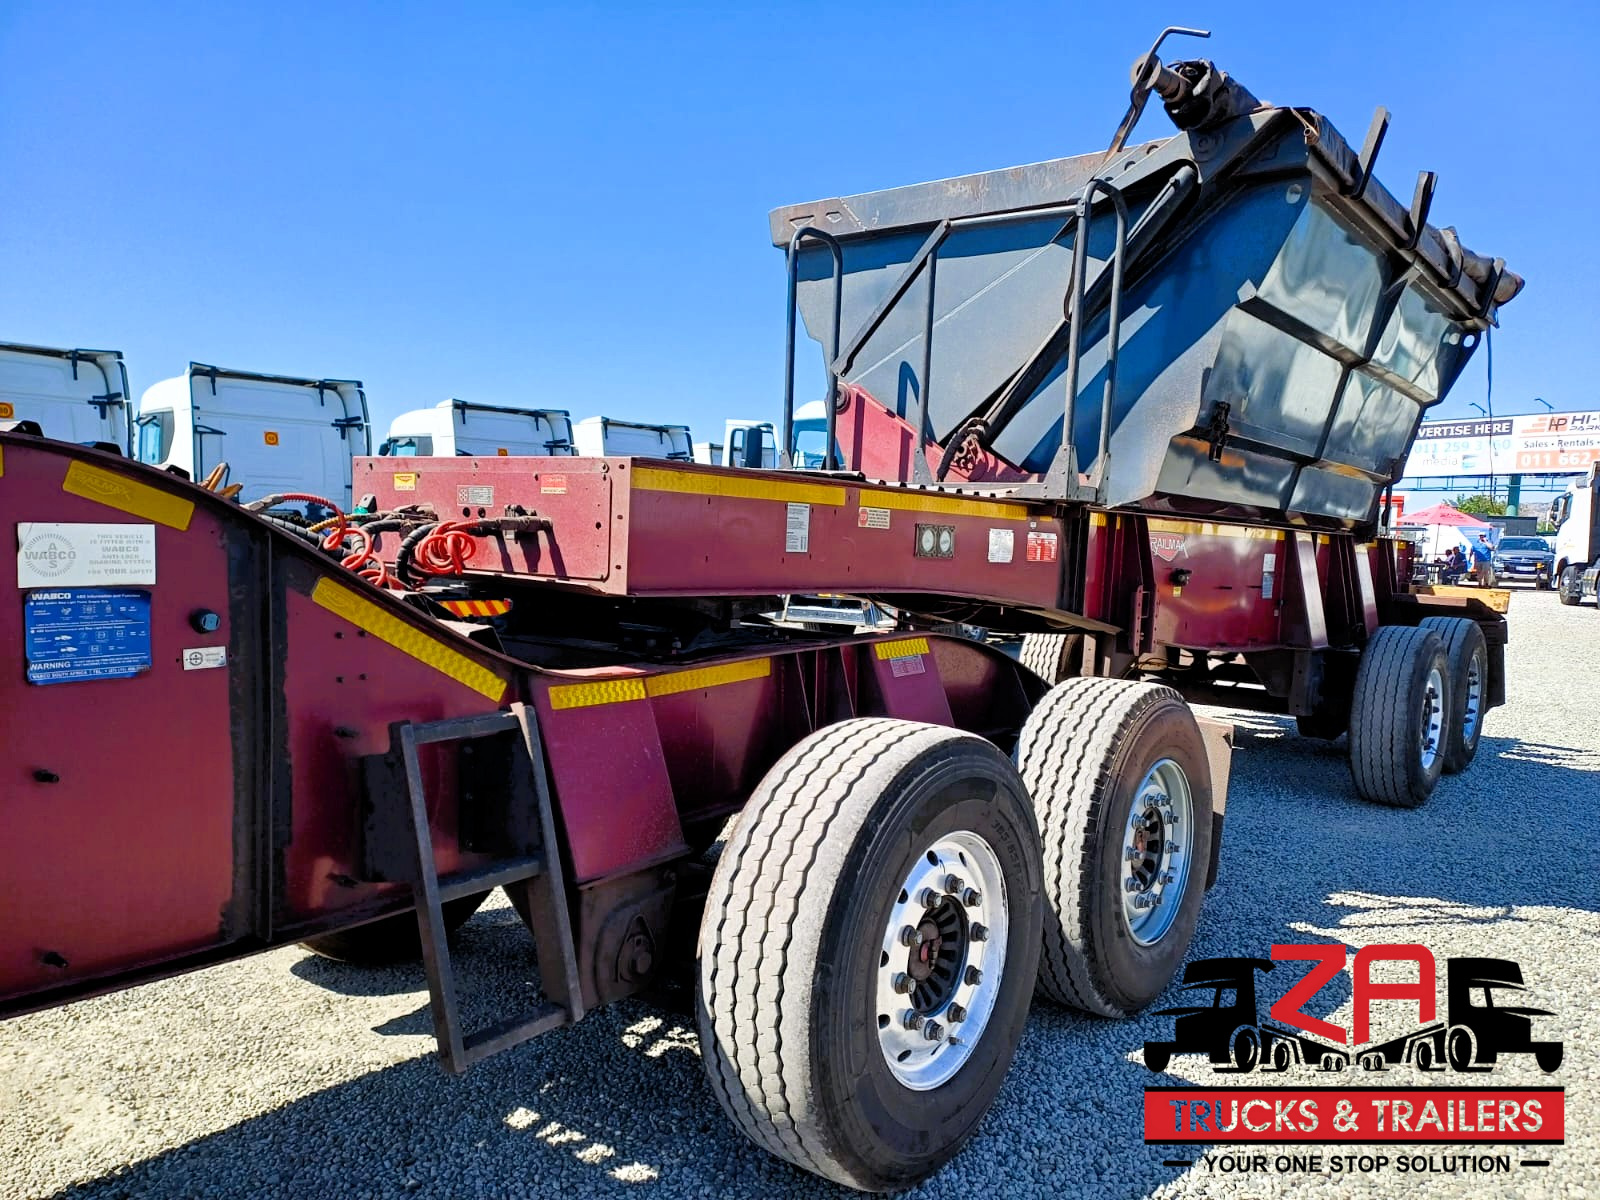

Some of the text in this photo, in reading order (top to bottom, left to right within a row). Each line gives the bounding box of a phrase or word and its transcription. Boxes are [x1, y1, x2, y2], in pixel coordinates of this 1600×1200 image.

[1571, 414, 1600, 425] HI-
[1418, 422, 1511, 438] VERTISE HERE
[1524, 438, 1594, 448] Sales Rentals
[1520, 452, 1592, 467] 011 662
[24, 551, 77, 560] WABCO
[31, 592, 72, 601] WABCO
[30, 661, 71, 671] WARNING
